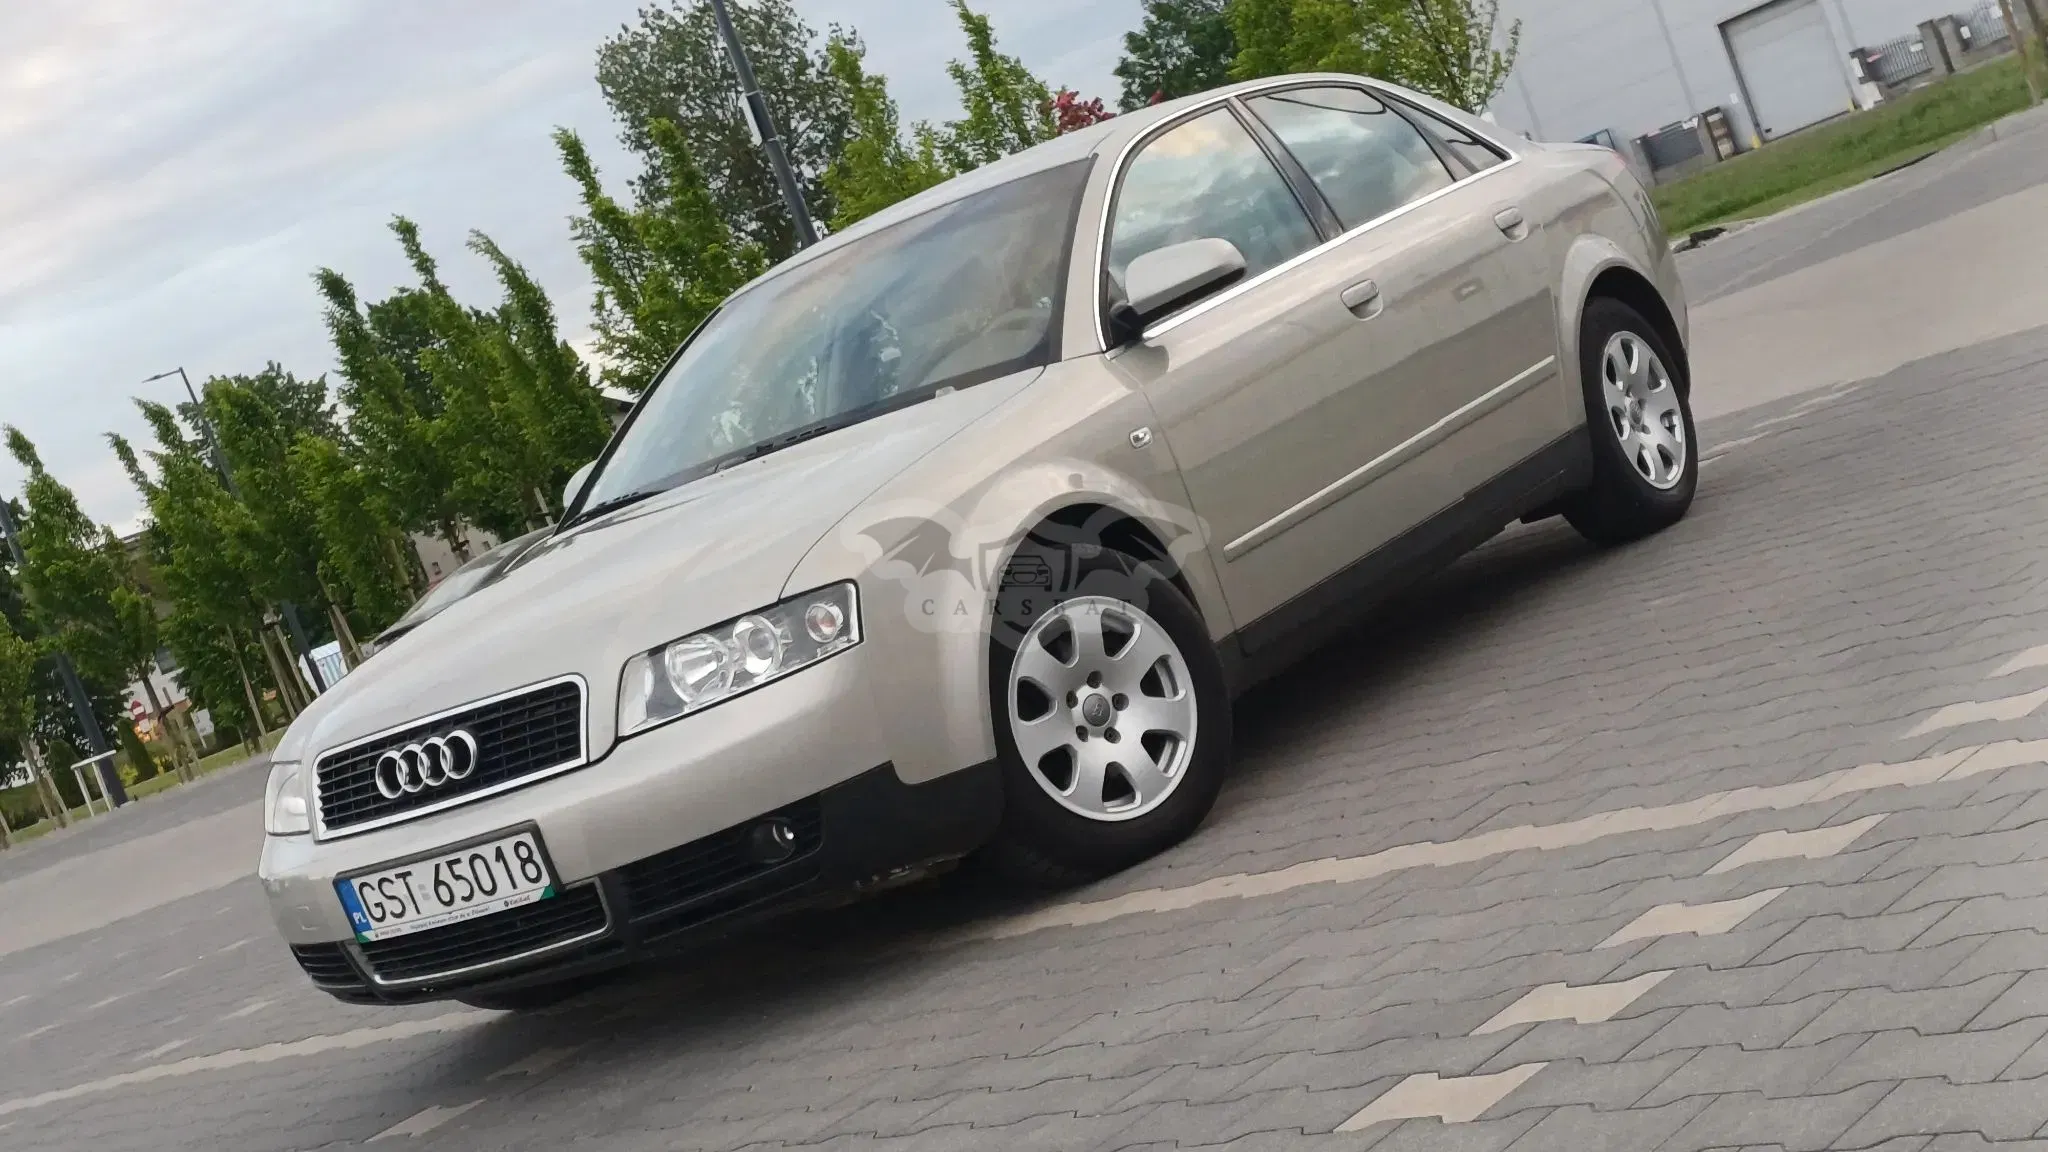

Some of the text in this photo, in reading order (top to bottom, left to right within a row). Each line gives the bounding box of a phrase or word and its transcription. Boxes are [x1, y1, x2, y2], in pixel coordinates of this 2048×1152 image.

[358, 870, 421, 923] GST
[433, 840, 543, 907] 65018
[353, 912, 367, 924] PL
